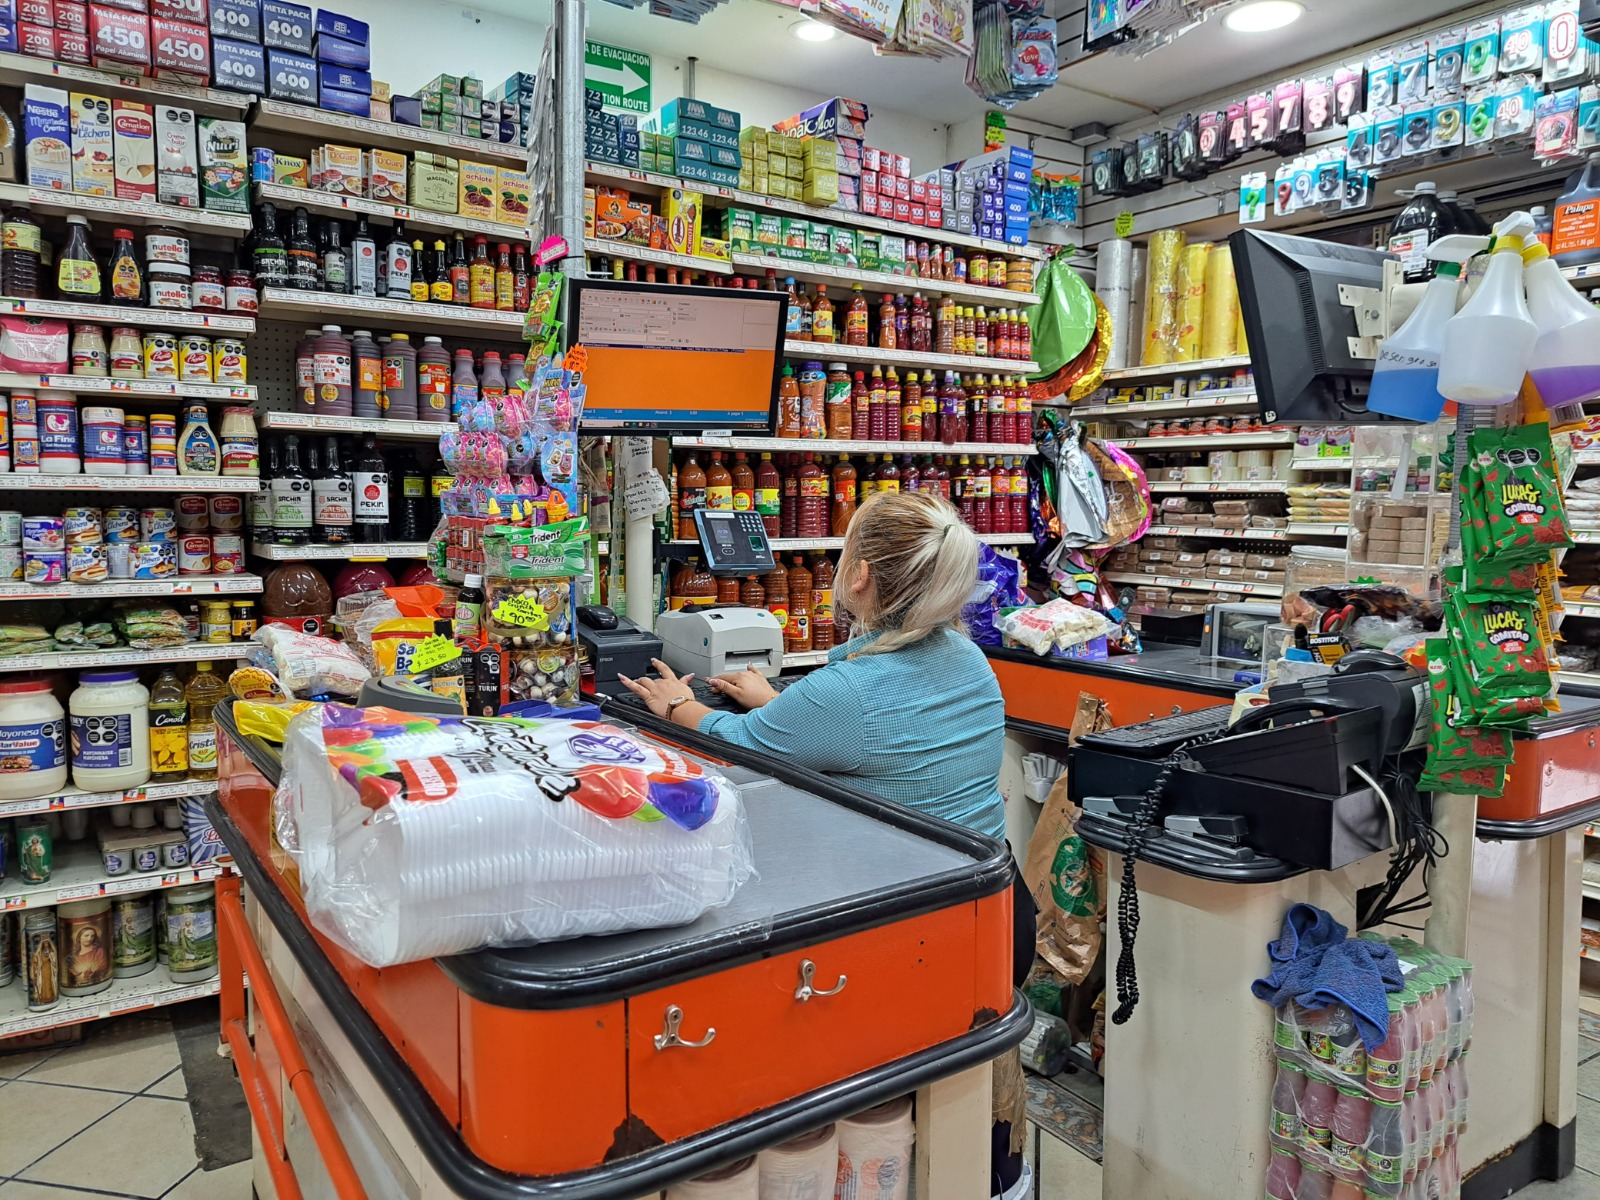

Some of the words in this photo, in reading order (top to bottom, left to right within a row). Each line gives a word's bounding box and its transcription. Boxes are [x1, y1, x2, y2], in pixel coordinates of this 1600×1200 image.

[23, 3, 47, 15] 200
[264, 4, 286, 15] META
[288, 9, 310, 20] PACK
[59, 10, 83, 22] 200
[94, 8, 119, 20] META
[121, 13, 146, 25] PACK
[154, 9, 173, 18] Papel
[176, 12, 204, 22] Aluminio
[214, 9, 250, 27] 400
[156, 22, 180, 33] META
[183, 28, 206, 37] PACK
[269, 20, 303, 38] 400
[26, 34, 50, 46] 200
[97, 25, 144, 49] 450
[63, 41, 86, 52] 200
[158, 38, 205, 61] 450
[265, 37, 283, 46] Papel
[285, 40, 309, 51] Aluminio
[96, 44, 116, 55] Papel
[118, 48, 147, 59] Aluminio
[215, 44, 237, 54] META
[240, 48, 262, 58] PACK
[591, 45, 602, 56] DE
[603, 48, 650, 67] EVACUACION
[158, 57, 177, 67] Papel
[179, 62, 207, 72] Aluminio
[220, 60, 255, 77] 400
[272, 56, 294, 66] META
[296, 60, 317, 71] PACK
[216, 76, 234, 87] Papel
[236, 80, 262, 90] Aluminio
[276, 72, 310, 89] 400
[272, 89, 289, 98] Papel
[291, 92, 316, 102] Aluminio
[623, 101, 648, 112] ROUTE
[117, 117, 151, 130] Carnation
[623, 116, 634, 126] 10
[819, 118, 835, 130] 400
[79, 129, 110, 138] Lechera
[682, 125, 709, 138] 123.46
[626, 134, 636, 143] 10
[712, 134, 737, 146] 123.46
[207, 139, 239, 151] Nutri
[275, 158, 301, 168] Knox
[681, 165, 707, 178] 123.46
[1014, 171, 1025, 179] 400
[466, 173, 492, 183] achiote
[712, 172, 737, 185] 123.46
[881, 178, 893, 188] 100
[964, 177, 973, 185] 50
[989, 178, 996, 186] 10
[503, 181, 529, 189] achiote
[913, 184, 925, 194] 100
[929, 188, 940, 198] 100
[865, 196, 877, 205] 100
[961, 196, 970, 204] 50
[984, 195, 992, 203] 10
[880, 200, 892, 210] 100
[896, 203, 909, 213] 100
[1010, 204, 1022, 212] 400
[1565, 204, 1594, 214] Palapa
[912, 207, 923, 216] 100
[928, 210, 940, 219] 100
[986, 210, 994, 218] 10
[995, 212, 1002, 221] 10
[961, 216, 970, 224] 50
[982, 225, 990, 234] 10
[995, 227, 1002, 235] 10
[1010, 235, 1022, 243] 400
[152, 243, 183, 253] nutella
[781, 249, 803, 258] ZUKO
[156, 290, 187, 299] nutella
[41, 435, 53, 443] La
[1502, 484, 1542, 505] LUCAS
[1505, 504, 1544, 516] GOMITAS
[529, 531, 561, 544] Trident
[530, 555, 565, 564] Trident
[533, 564, 564, 572] XtraCare
[1483, 611, 1526, 633] LUCAS
[1310, 636, 1339, 644] BOSTITCH
[1489, 631, 1530, 644] GOMITAS
[398, 643, 416, 655] Sa
[479, 684, 497, 692] TURIN
[155, 715, 185, 726] Canoil
[189, 737, 216, 750] Crista
